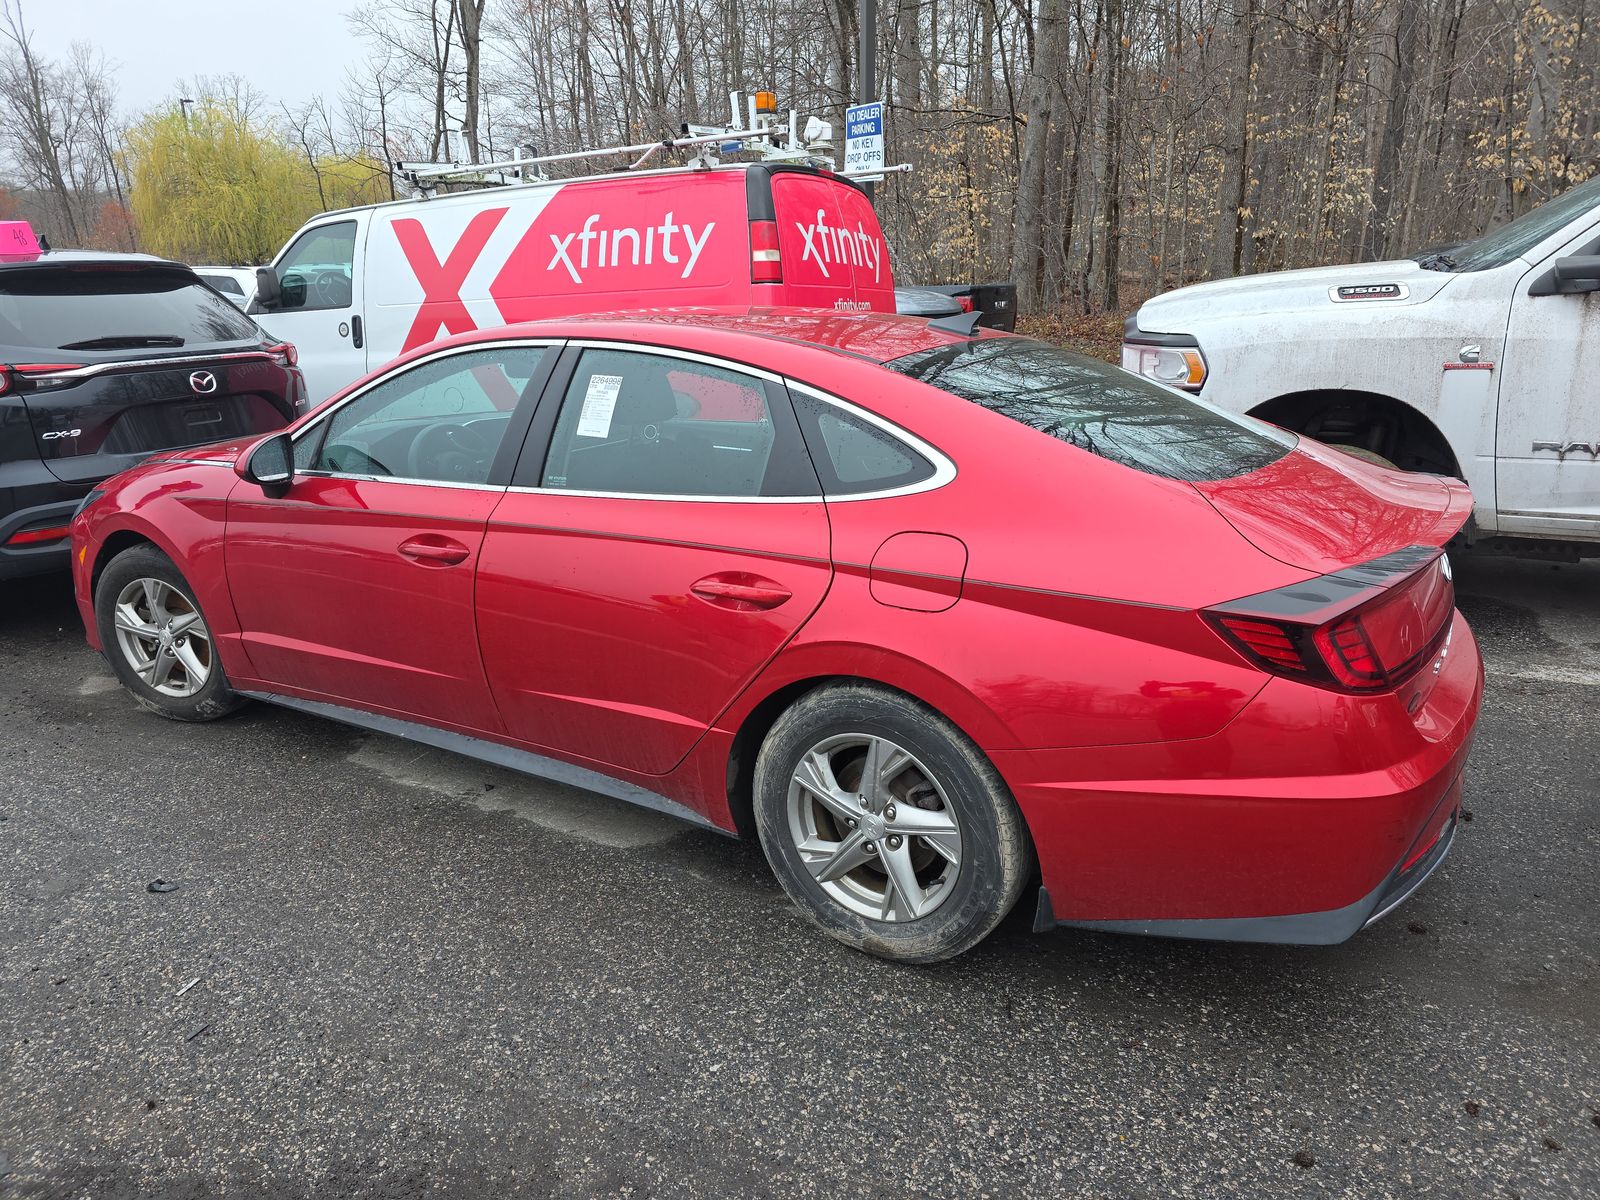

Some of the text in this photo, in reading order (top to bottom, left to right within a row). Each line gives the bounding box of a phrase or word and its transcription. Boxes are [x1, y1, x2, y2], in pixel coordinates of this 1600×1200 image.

[848, 107, 880, 123] NO DEALER
[851, 122, 875, 136] PARKING
[852, 138, 874, 150] NO KEY
[847, 151, 881, 164] DROP OFFS
[546, 211, 716, 285] xfinity
[795, 208, 881, 283] xfinity
[1341, 285, 1395, 295] 3500
[833, 297, 872, 311] xfinity.com
[42, 428, 82, 440] CX-9
[1531, 439, 1600, 454] RA
